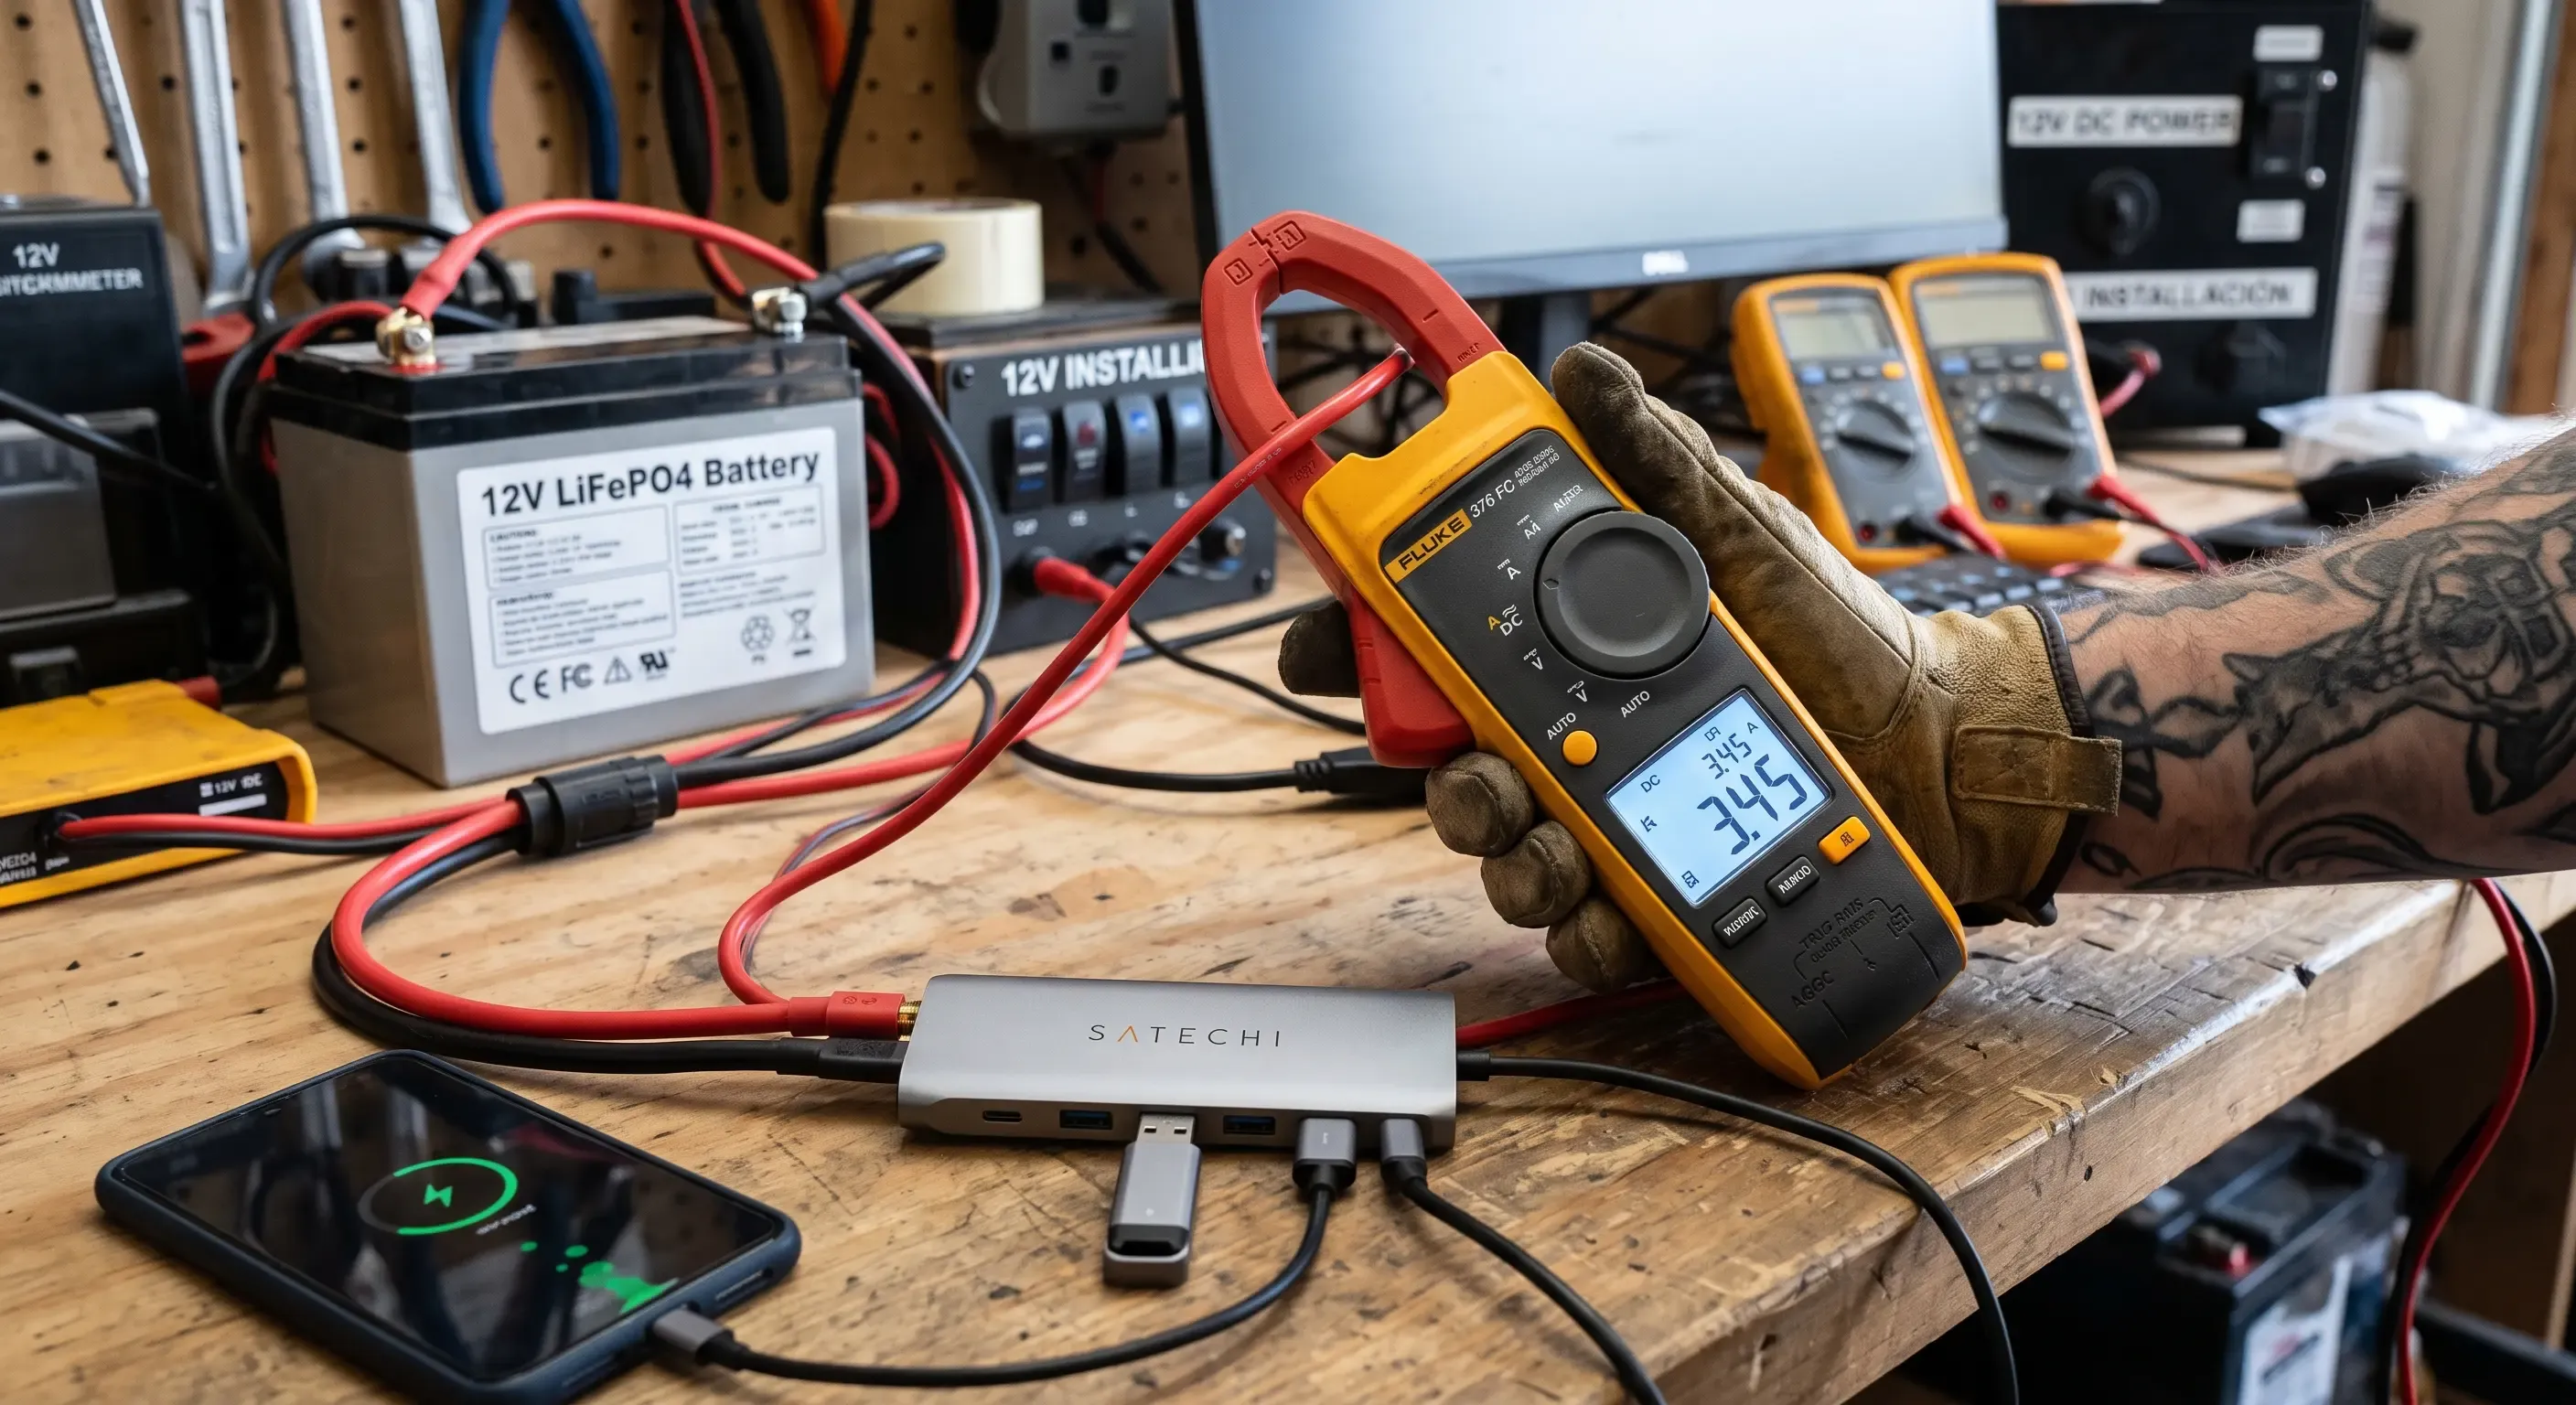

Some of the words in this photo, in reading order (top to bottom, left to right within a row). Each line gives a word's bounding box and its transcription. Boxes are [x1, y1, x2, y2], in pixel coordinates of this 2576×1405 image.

[13, 241, 59, 269] 12V
[1001, 355, 1059, 396] 12V
[481, 481, 544, 518] 12V
[557, 467, 694, 509] LiFePO4
[705, 453, 820, 488] Battery
[1398, 517, 1465, 572] FLUKE
[1470, 493, 1496, 518] 376
[1495, 479, 1515, 500] FC
[1487, 616, 1500, 630] A
[1500, 613, 1523, 637] DC
[1620, 691, 1650, 718] AUTO
[1547, 713, 1577, 741] AUTO
[1747, 722, 1758, 734] A
[1701, 733, 1752, 779] 3.45
[1640, 775, 1660, 793] DC
[1697, 754, 1808, 855] 3.45
[1089, 1024, 1280, 1047] SATECHI
